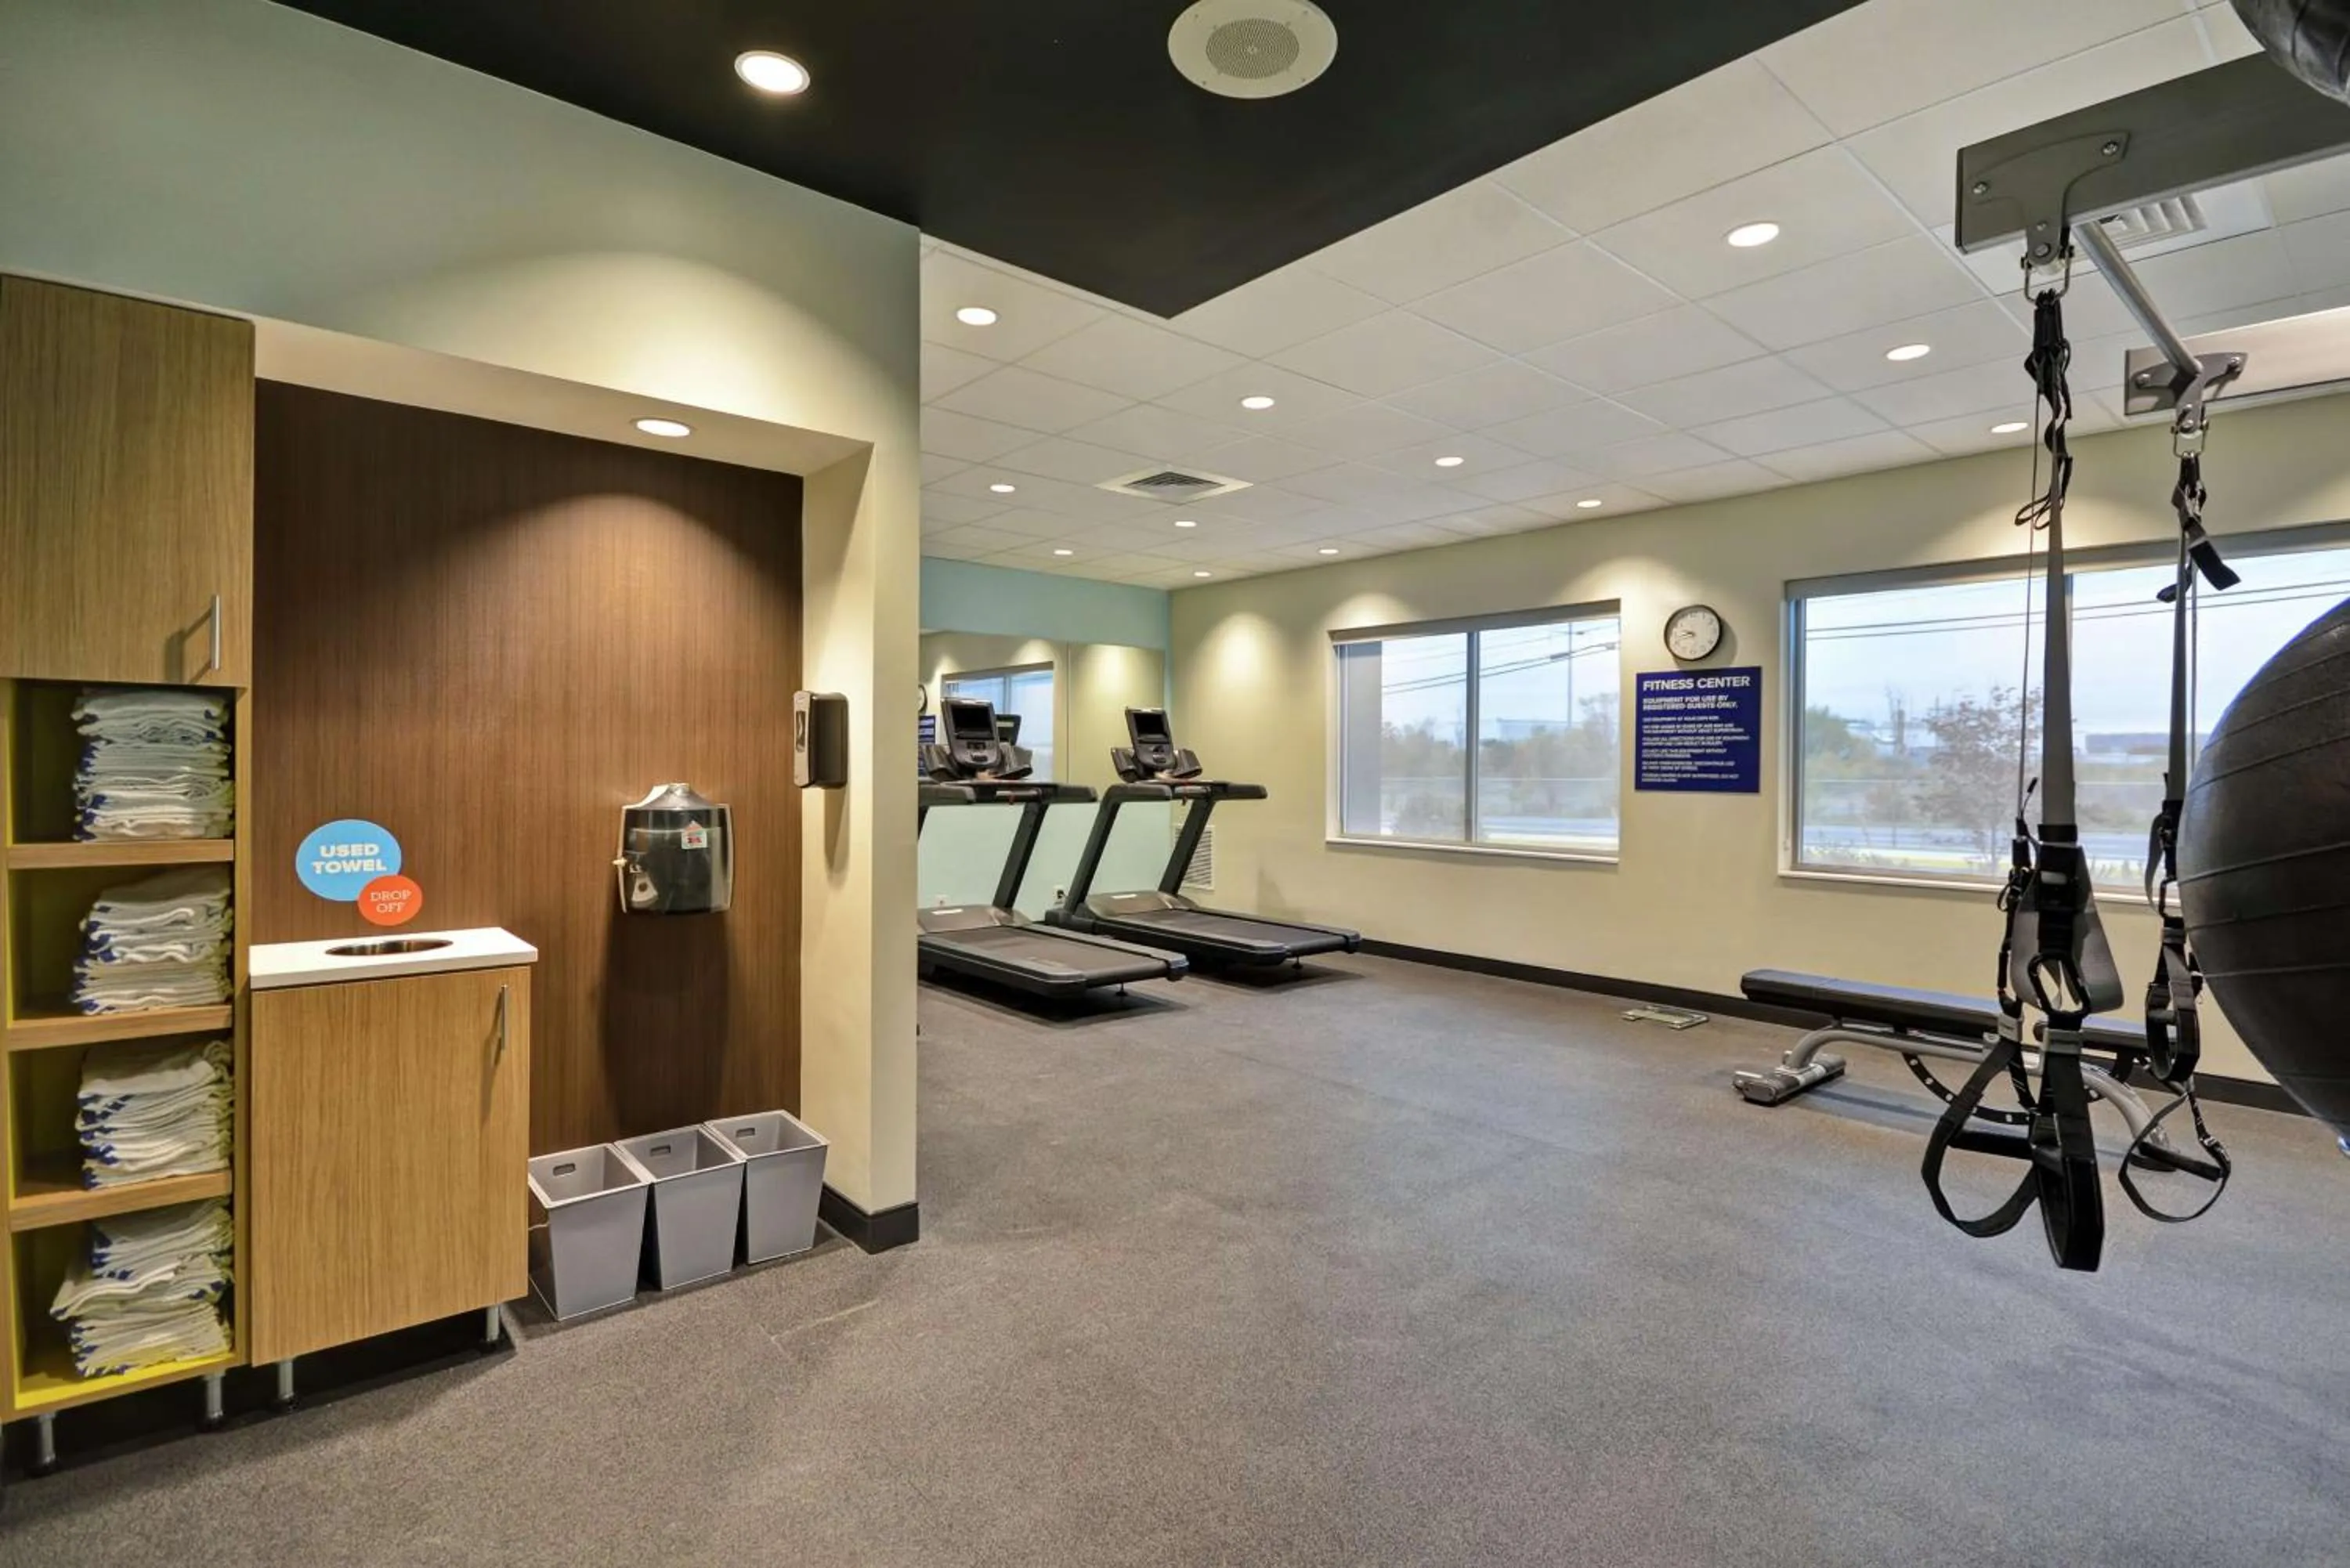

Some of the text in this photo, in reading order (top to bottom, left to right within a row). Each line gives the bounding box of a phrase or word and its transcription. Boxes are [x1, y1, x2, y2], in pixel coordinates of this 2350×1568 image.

[1643, 676, 1751, 691] FITNESS CENTER
[320, 843, 380, 858] USED
[311, 858, 387, 874] TOWEL
[370, 890, 412, 902] DROP
[376, 902, 405, 913] OFF
